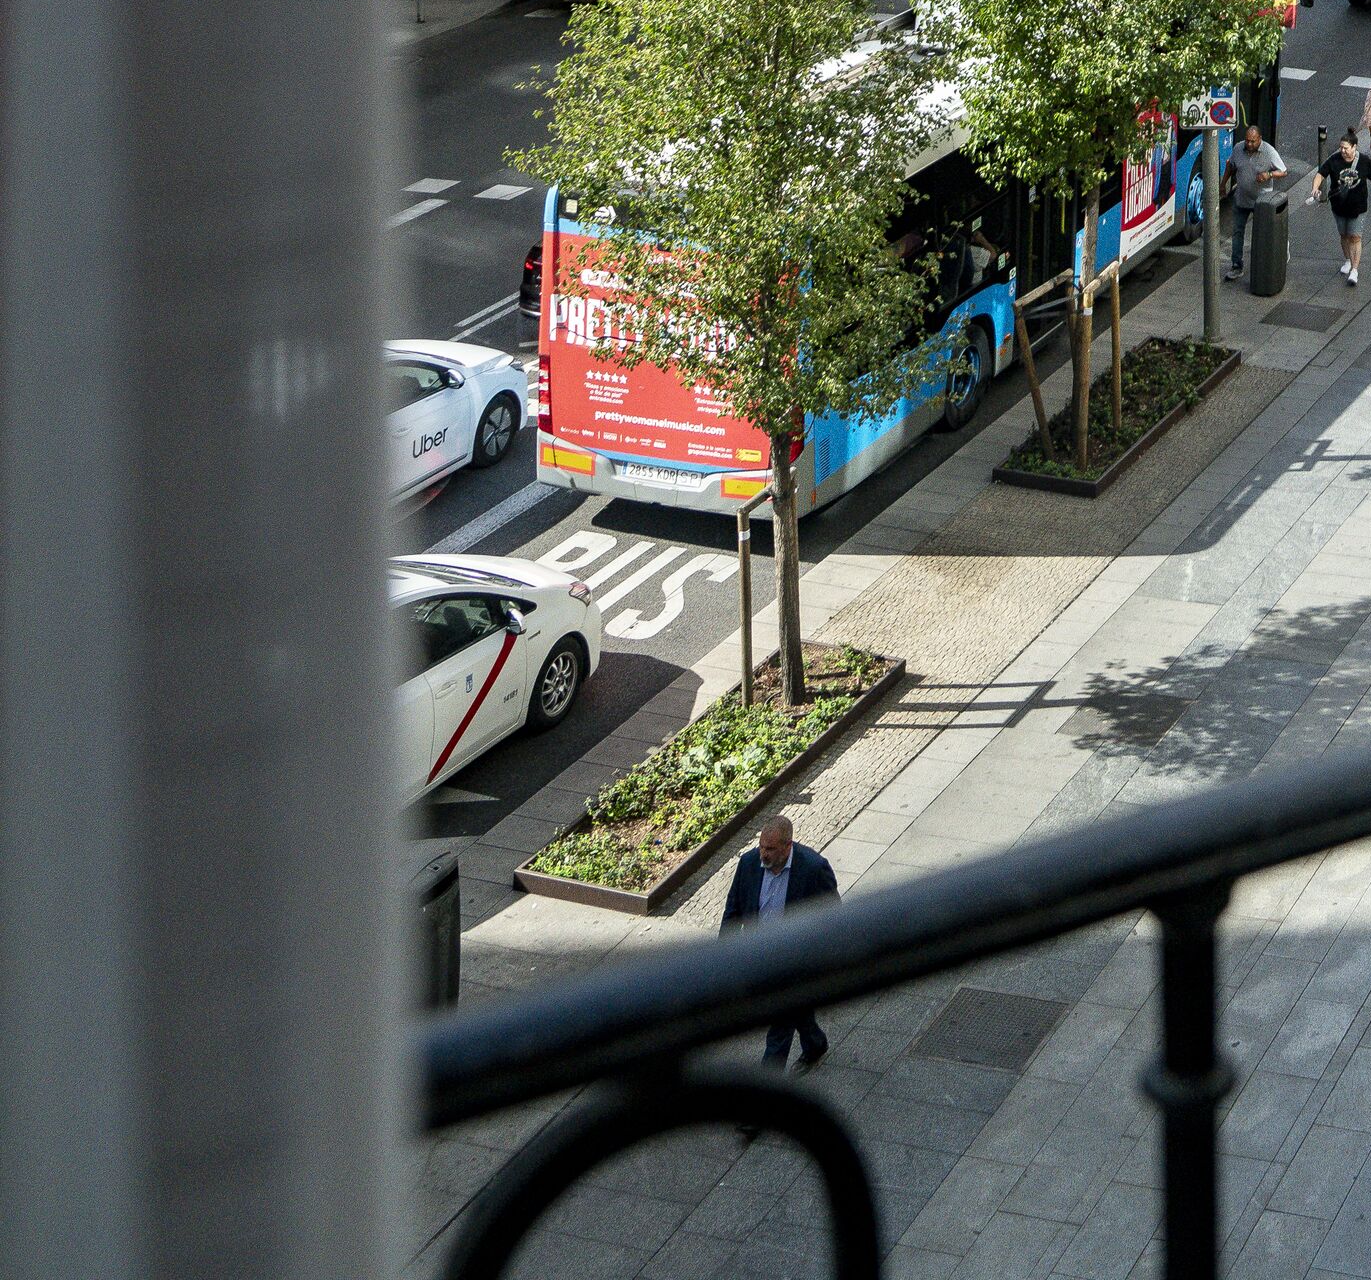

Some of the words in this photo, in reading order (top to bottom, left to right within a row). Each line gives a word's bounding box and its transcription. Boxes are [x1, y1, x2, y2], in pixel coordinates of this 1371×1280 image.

[594, 409, 726, 437] prettywomanelmusical.com
[411, 426, 449, 459] Uber
[629, 464, 654, 479] 2855
[657, 466, 676, 482] KDR
[535, 530, 740, 640] BUS
